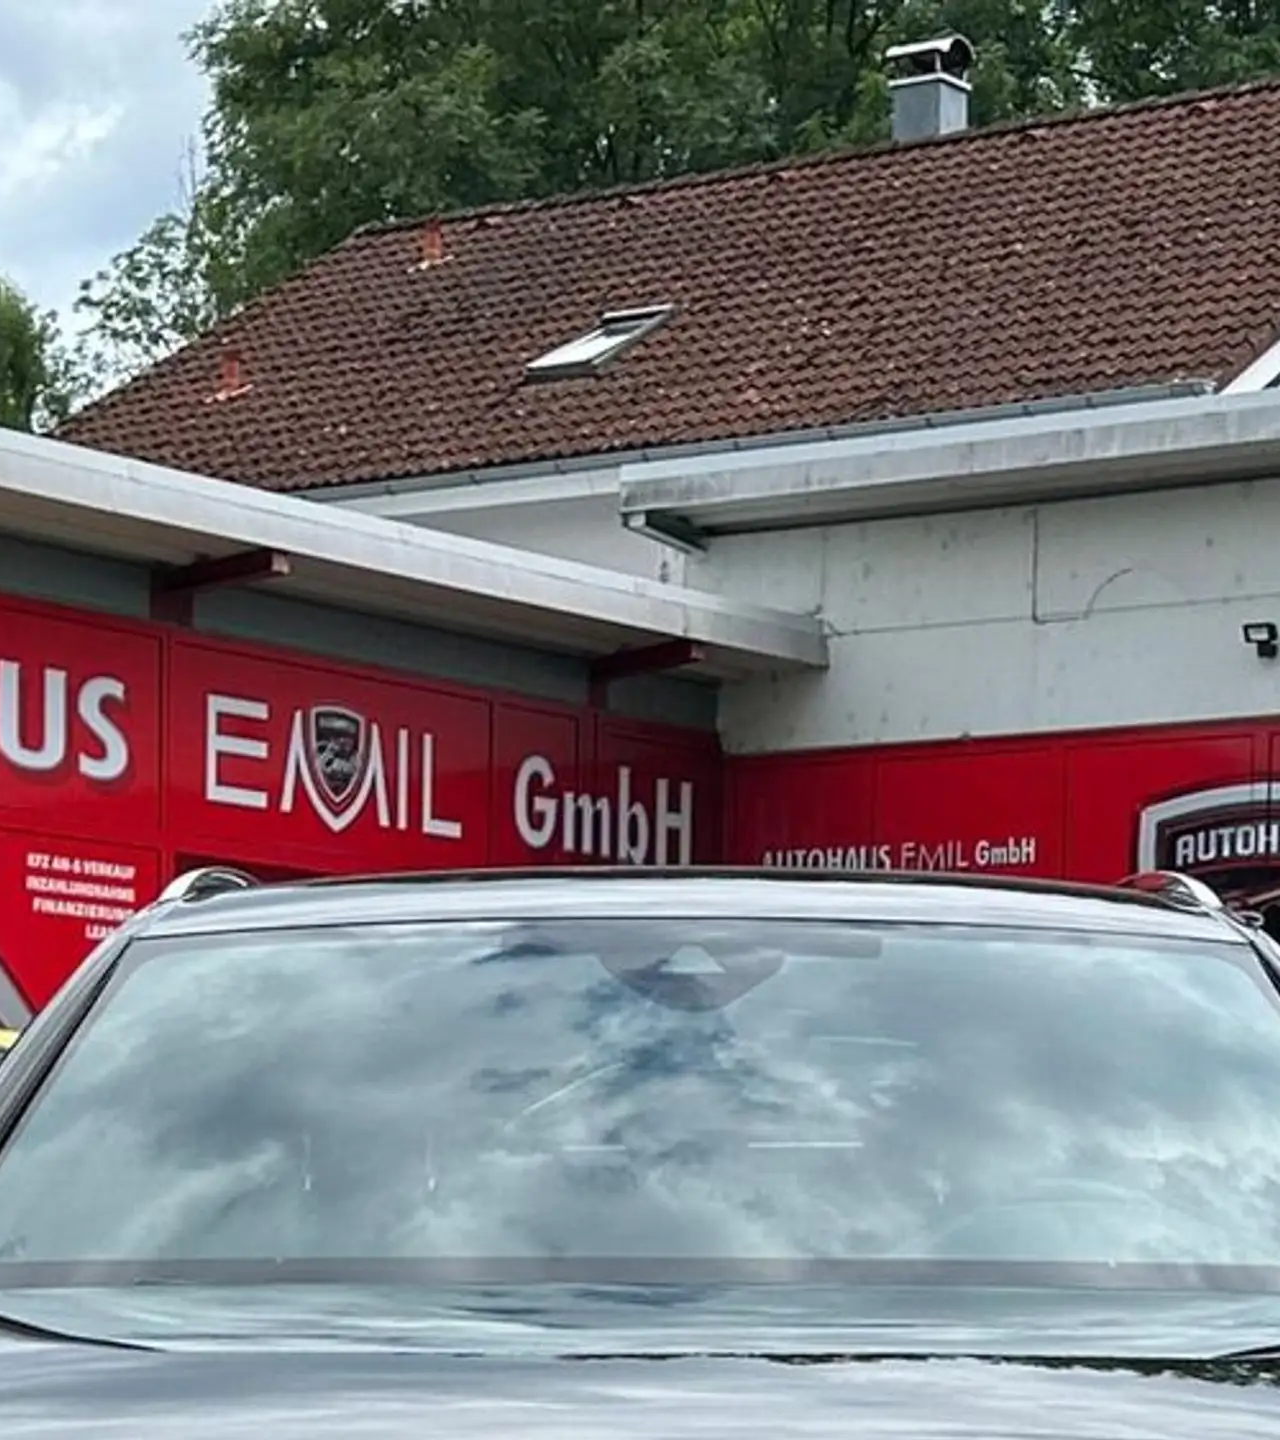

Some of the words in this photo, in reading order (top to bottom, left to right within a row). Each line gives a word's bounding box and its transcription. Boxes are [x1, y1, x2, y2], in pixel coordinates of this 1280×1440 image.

[206, 693, 462, 838] EMIL
[514, 755, 693, 867] GmbH
[900, 841, 969, 870] EMIL
[975, 836, 1036, 866] GmbH
